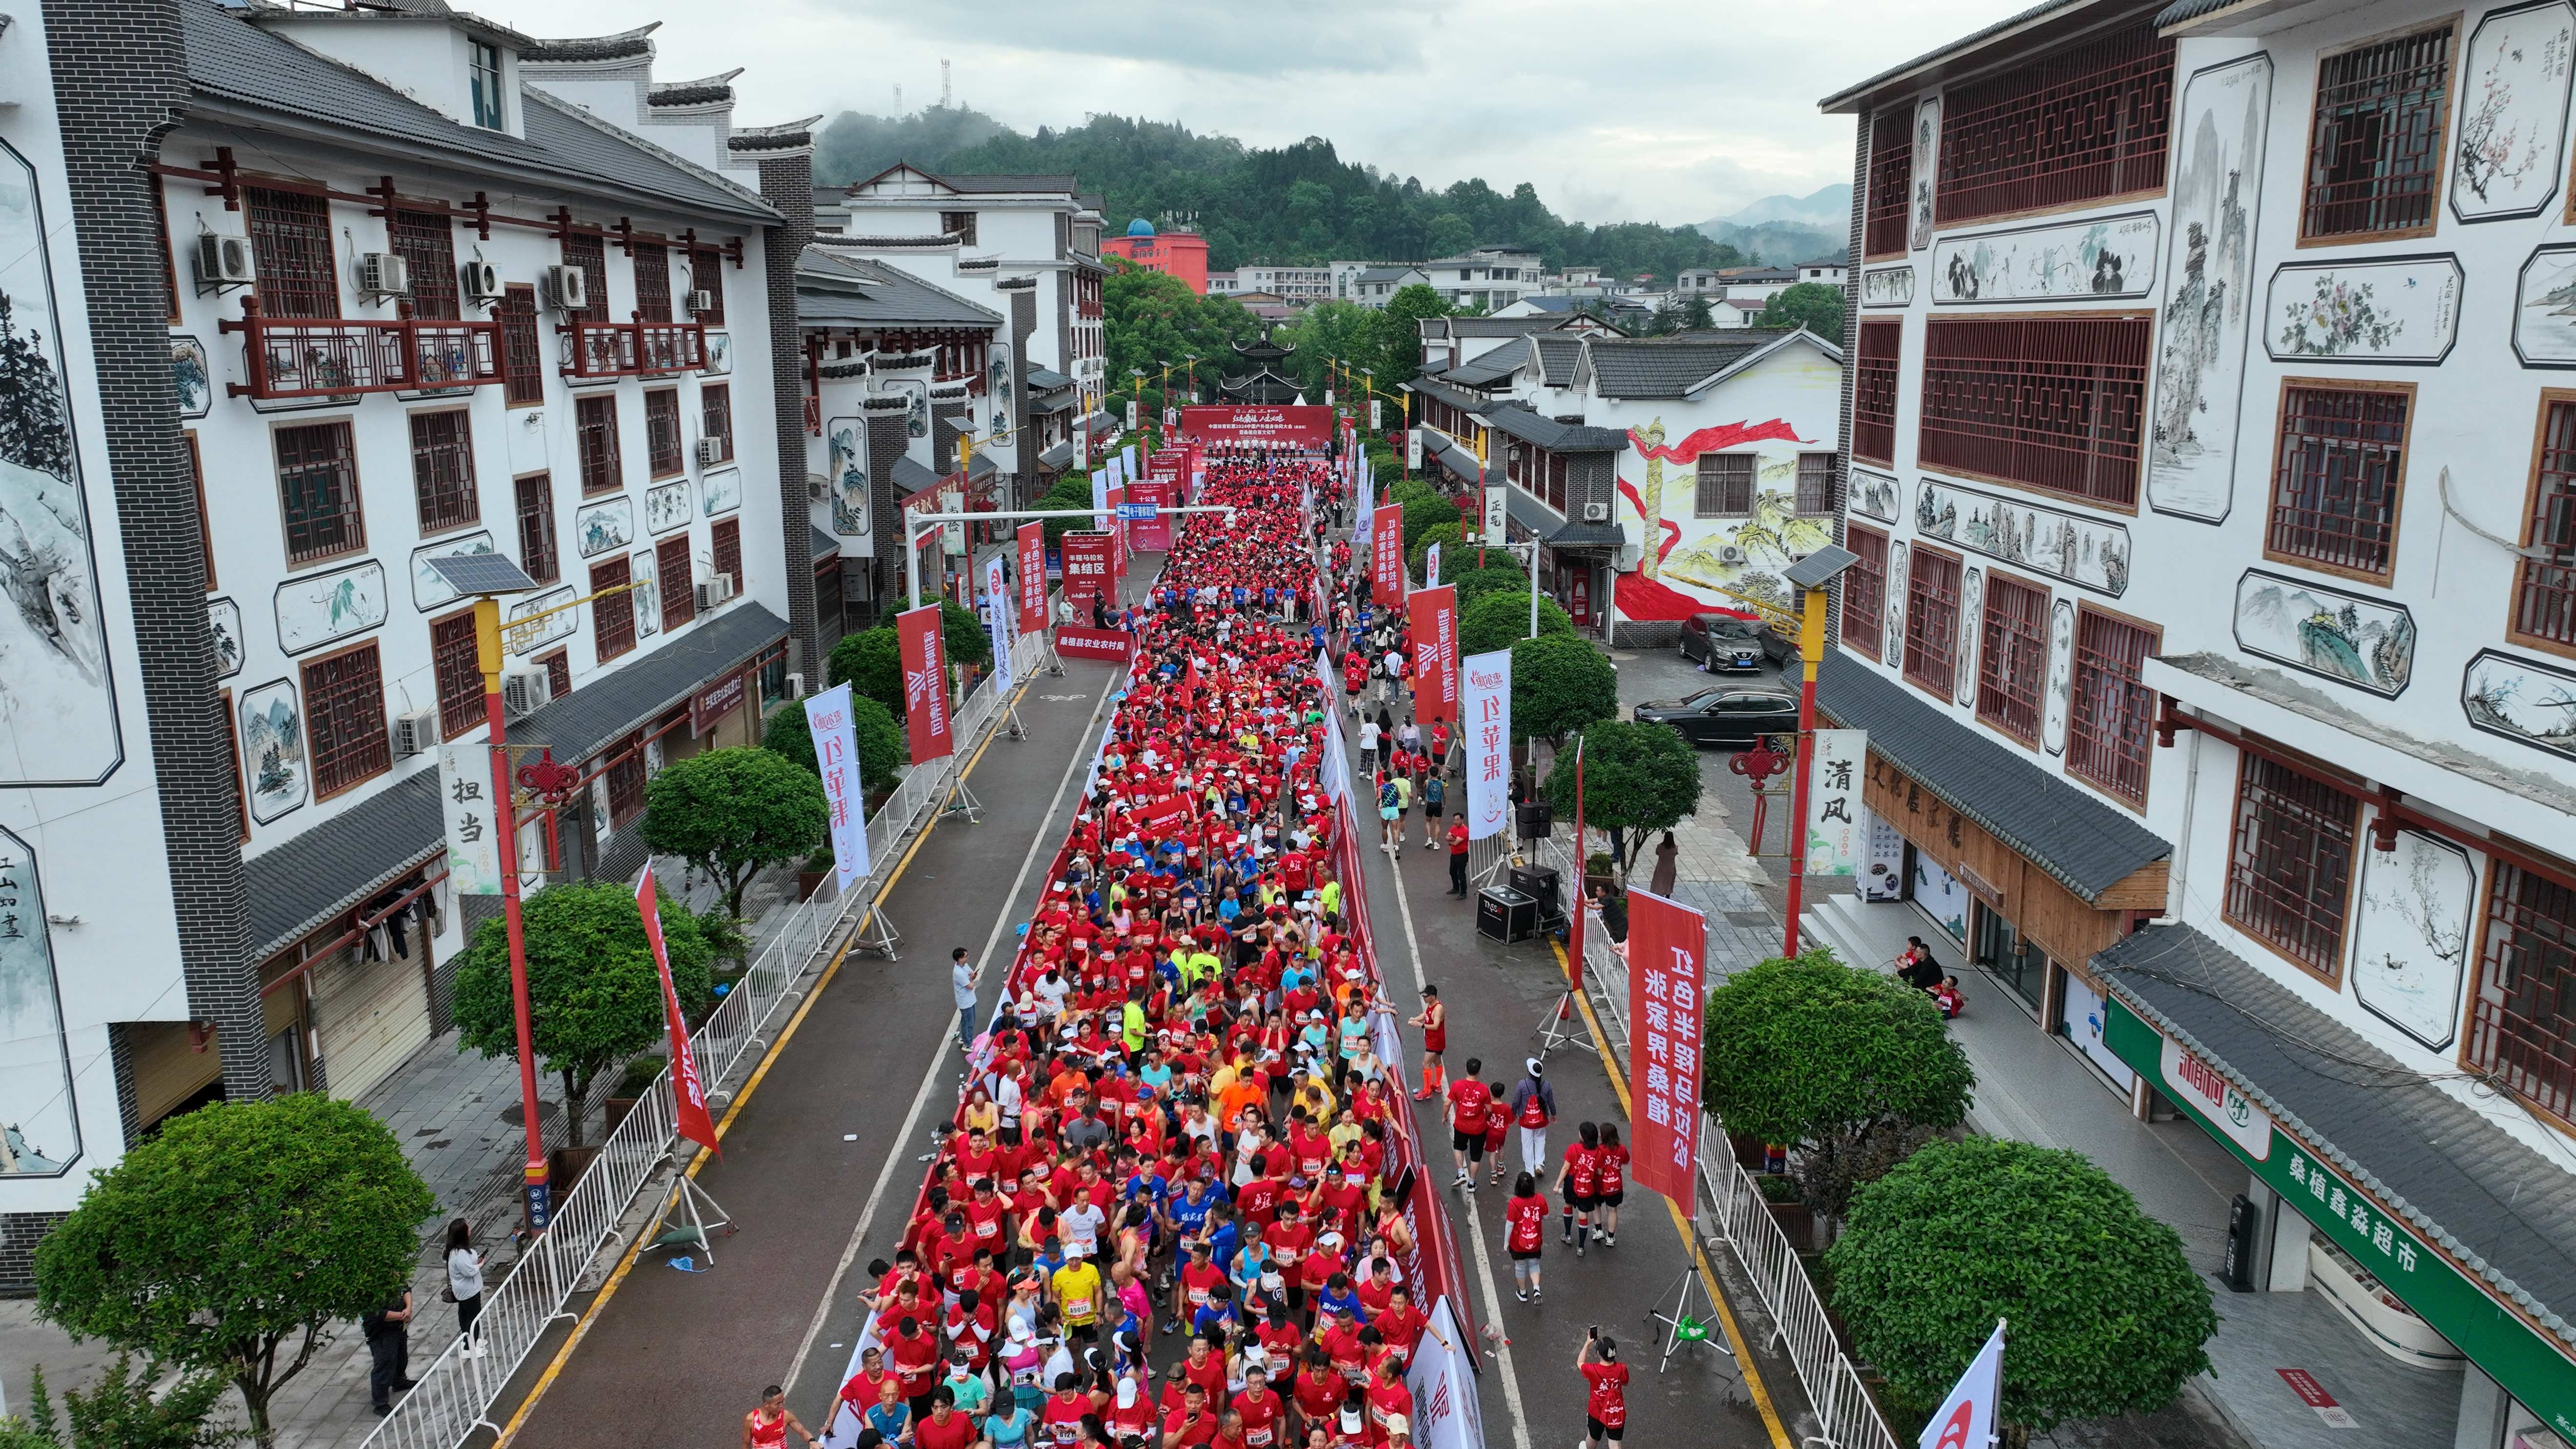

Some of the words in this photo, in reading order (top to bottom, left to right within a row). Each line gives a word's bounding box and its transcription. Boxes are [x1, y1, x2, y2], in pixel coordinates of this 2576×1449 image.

[1076, 439, 1083, 456] 严明
[1411, 439, 1419, 455] 诚信
[1129, 506, 1155, 517] 电子警察取证
[1490, 500, 1502, 527] 正气
[1068, 563, 1106, 575] 集结区
[1060, 637, 1125, 651] 桑植县农业农村局
[1821, 759, 1853, 825] 清风
[452, 777, 483, 844] 担当
[1874, 825, 1882, 857] 手工制品
[1883, 825, 1891, 858] 桑植白茶
[1891, 834, 1900, 858] 族扎染
[2289, 1152, 2418, 1273] 桑植鑫淼超市
